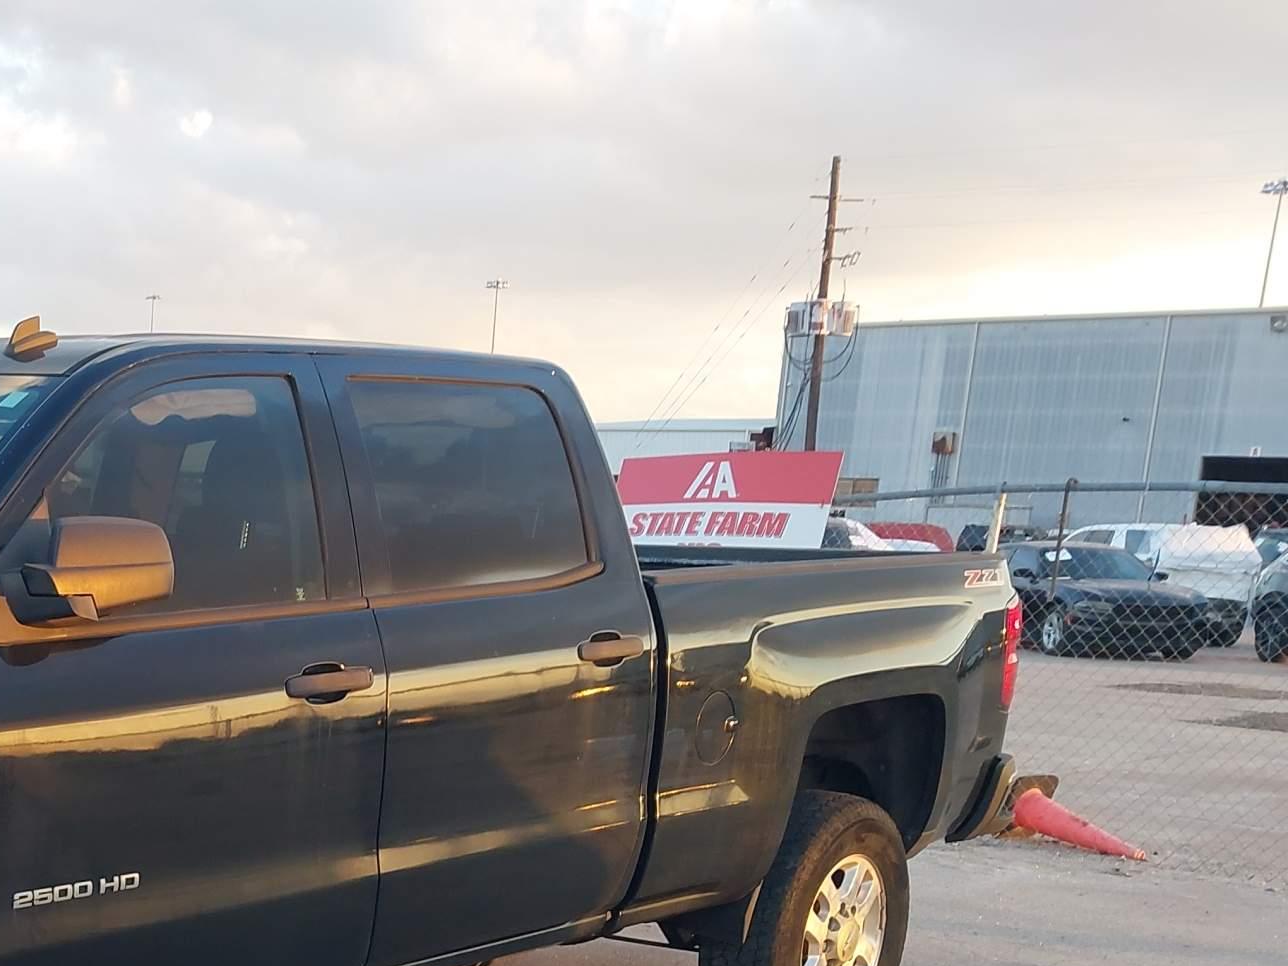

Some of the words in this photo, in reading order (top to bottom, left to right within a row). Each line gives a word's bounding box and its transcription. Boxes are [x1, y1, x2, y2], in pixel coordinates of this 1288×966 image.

[629, 511, 704, 538] STATE
[704, 511, 791, 539] FARM
[13, 881, 93, 909] 2500
[99, 872, 140, 894] HD
